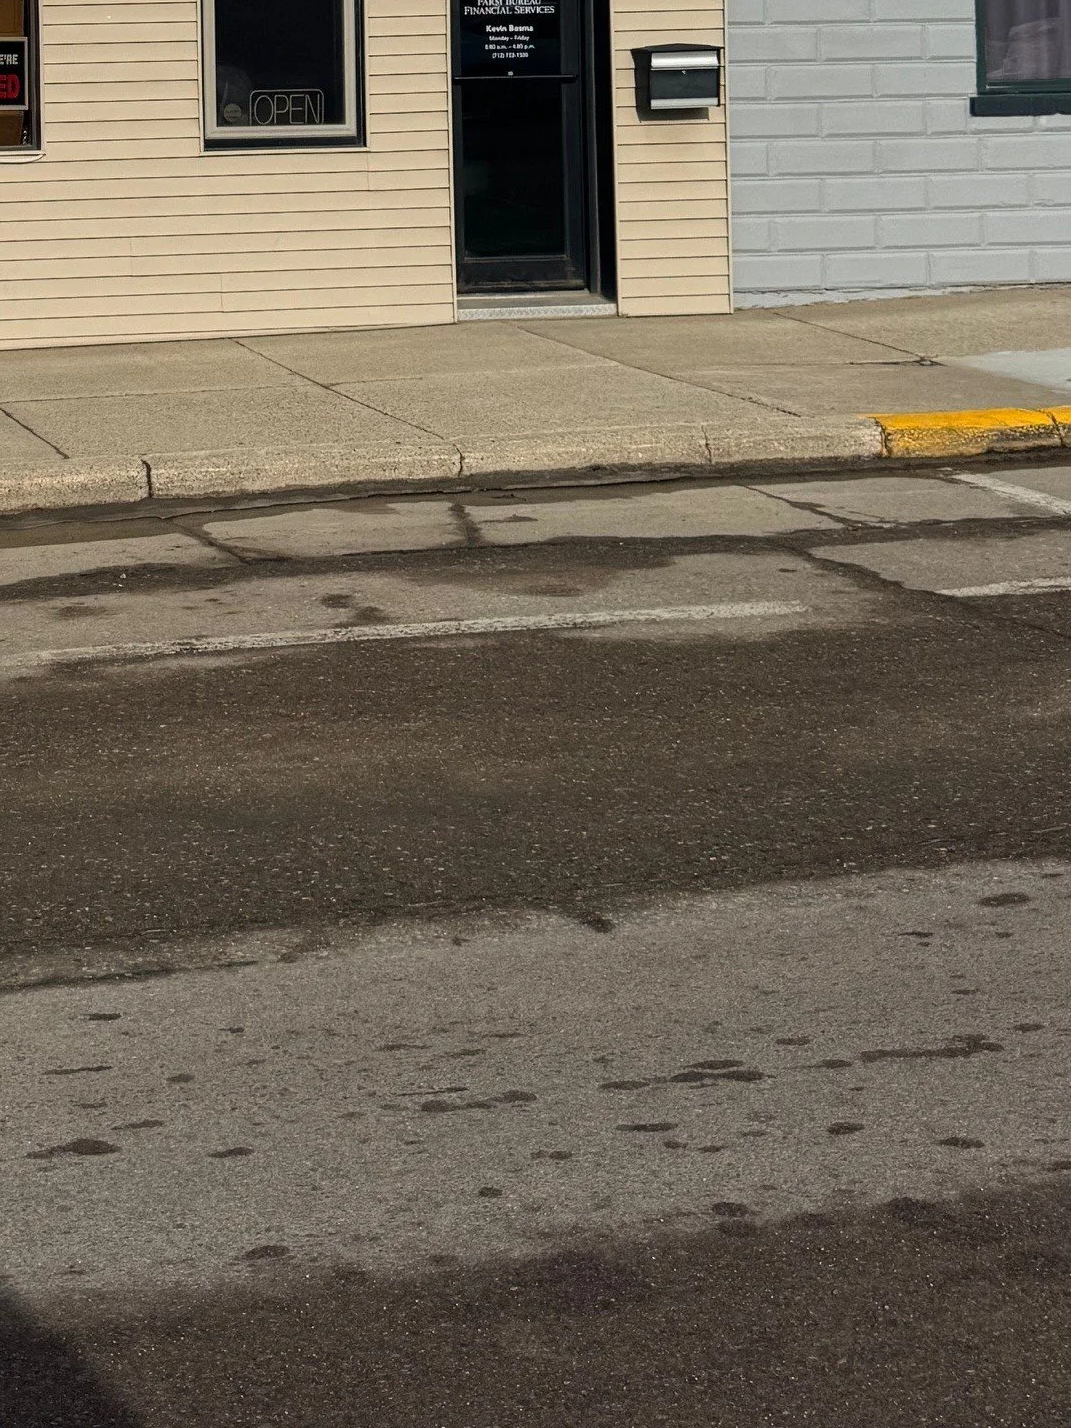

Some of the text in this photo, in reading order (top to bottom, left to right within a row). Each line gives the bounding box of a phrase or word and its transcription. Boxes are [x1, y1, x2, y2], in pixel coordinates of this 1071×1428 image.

[464, 6, 555, 15] FINANCIAL SERVICES
[509, 24, 534, 32] Bosma
[254, 93, 320, 125] OPEN
